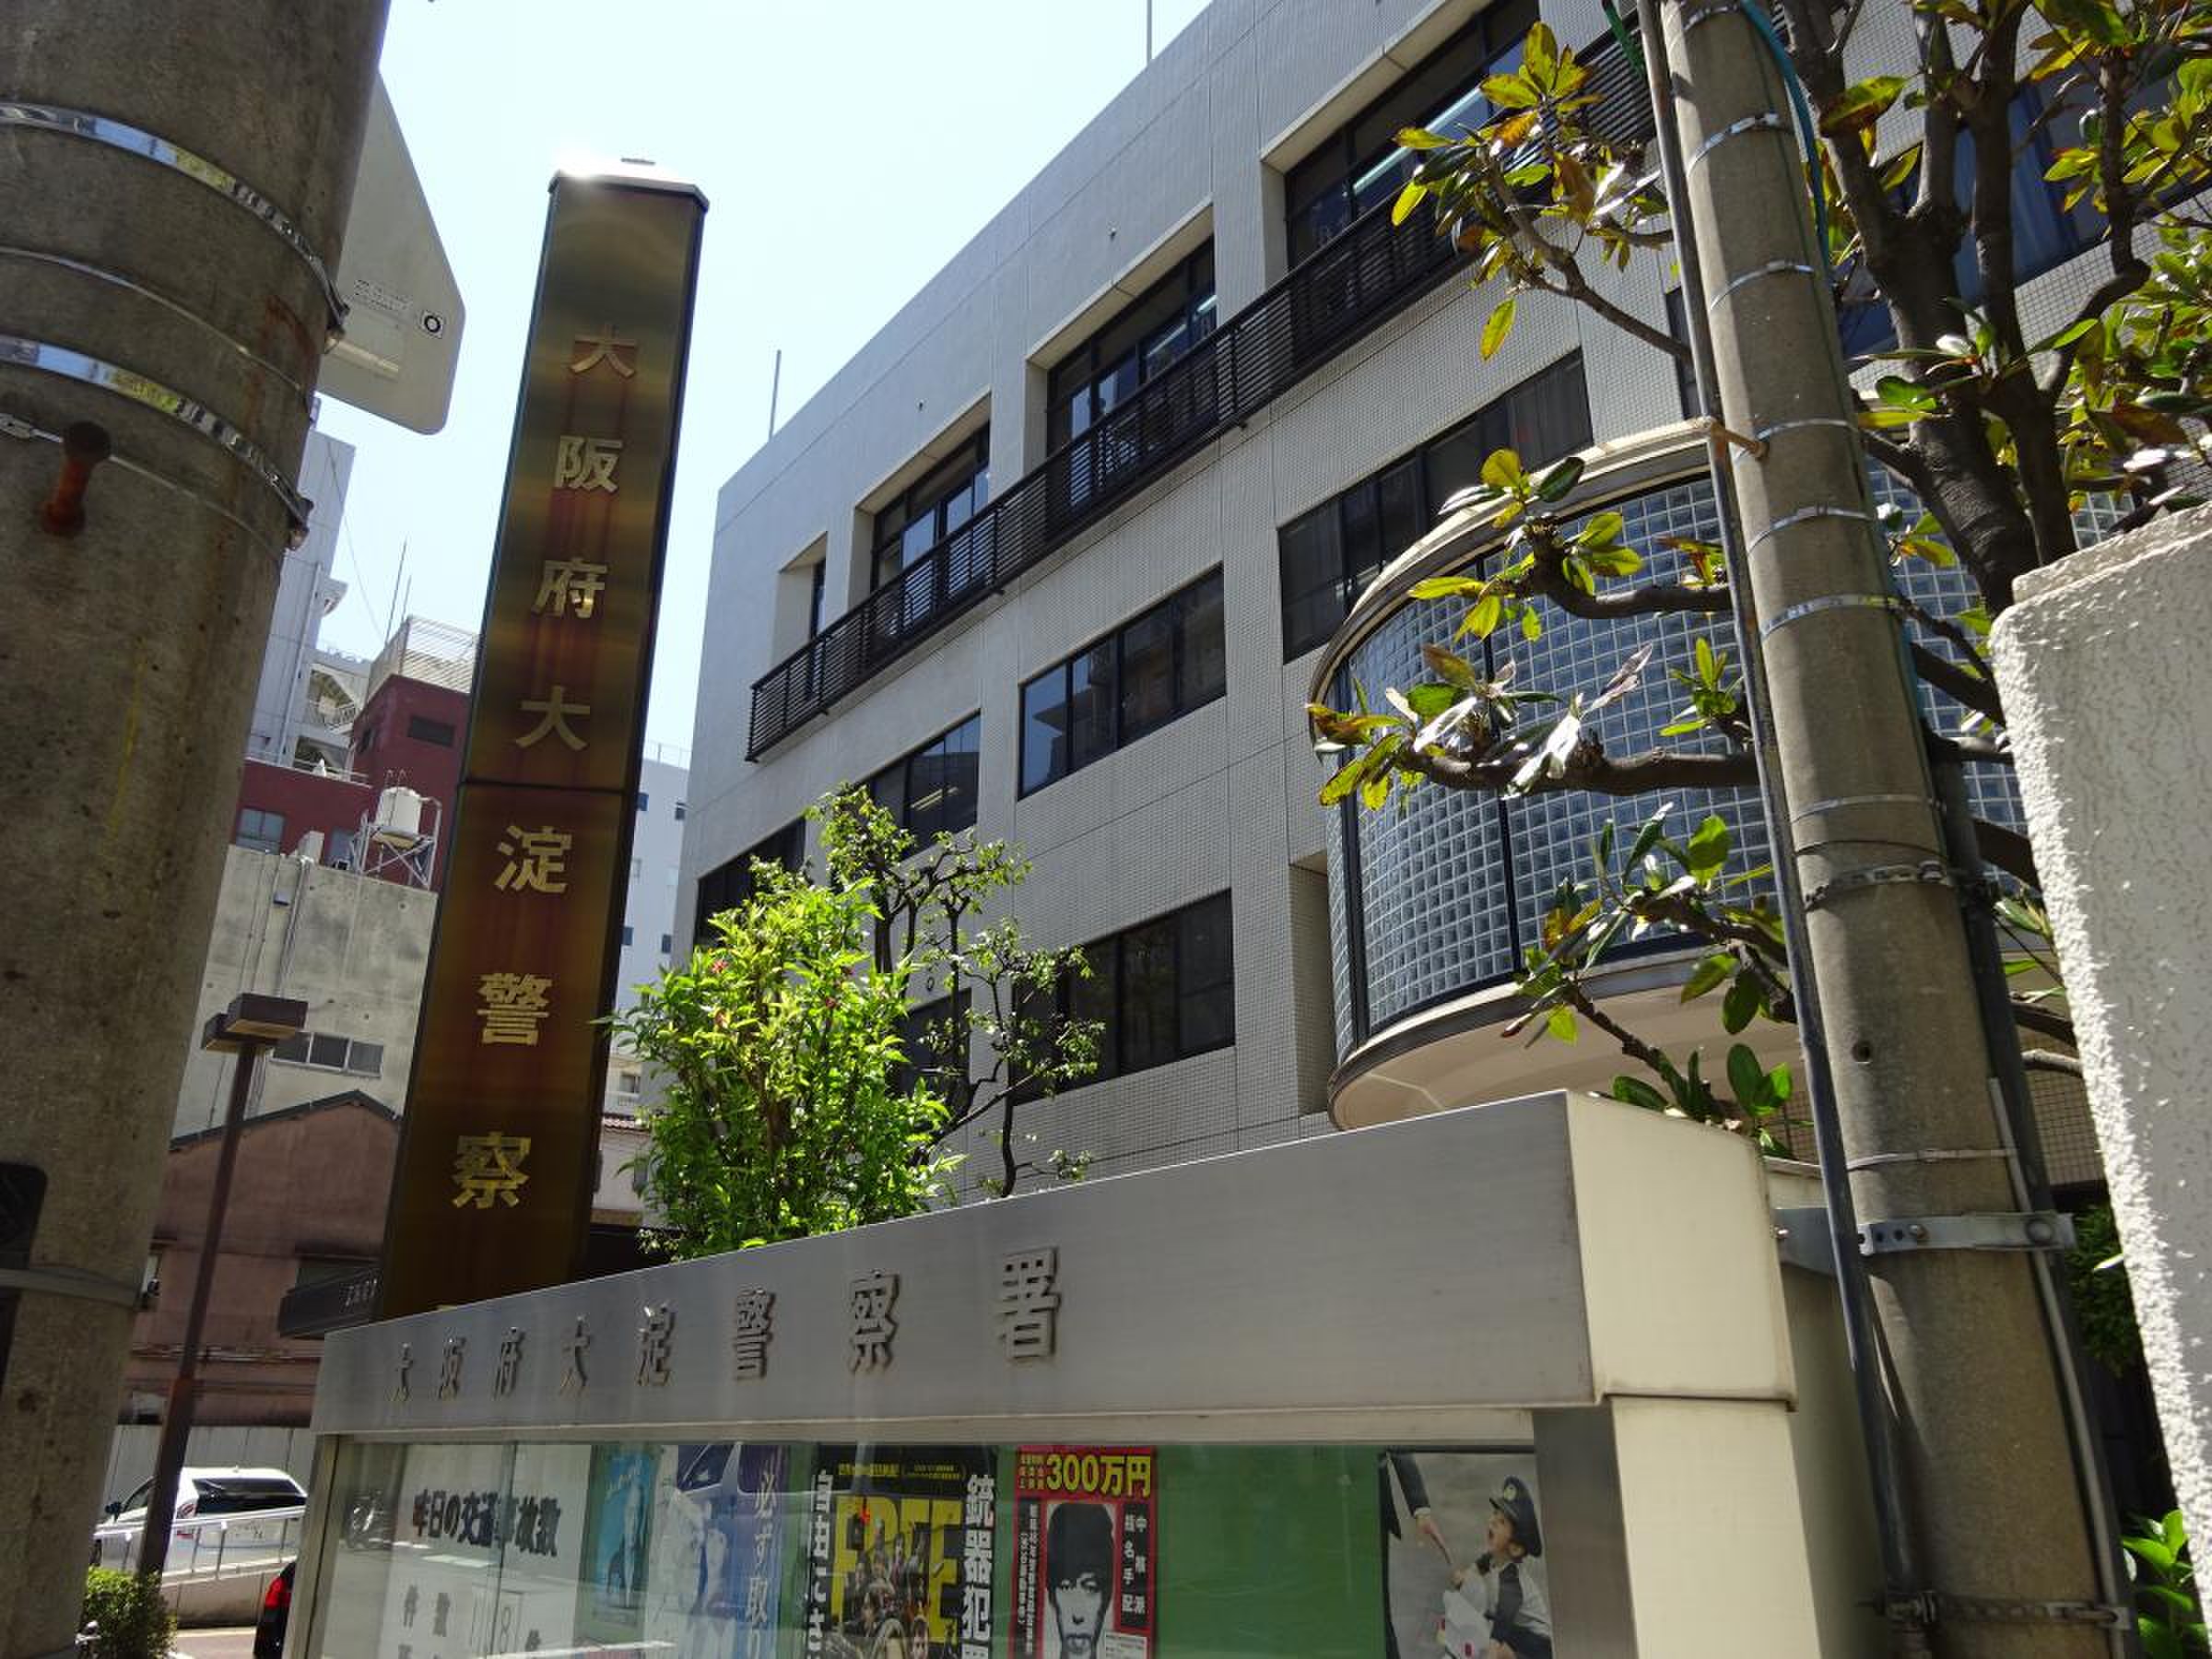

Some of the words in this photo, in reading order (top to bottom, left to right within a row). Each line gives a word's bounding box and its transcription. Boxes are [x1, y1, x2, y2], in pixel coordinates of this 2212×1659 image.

[452, 324, 638, 1209] 大阪府大淀警察
[389, 1247, 1061, 1402] 大阪府大淀警察署
[1047, 1453, 1151, 1497] 300万円
